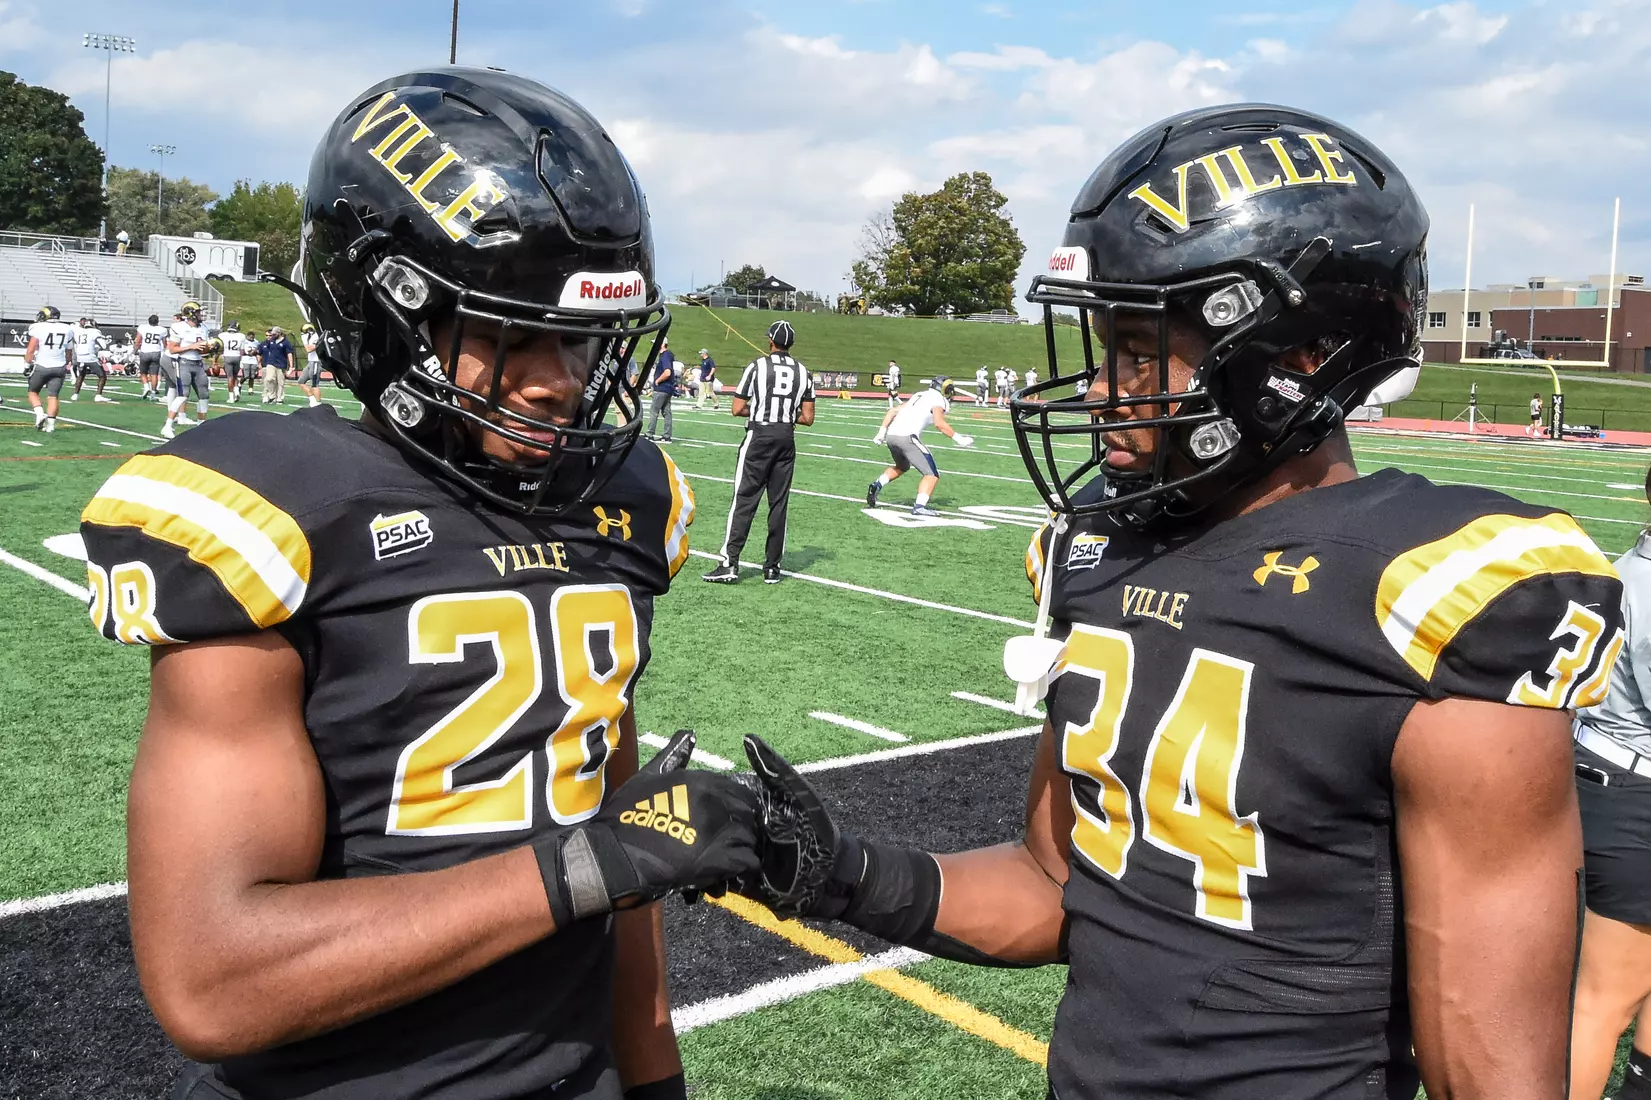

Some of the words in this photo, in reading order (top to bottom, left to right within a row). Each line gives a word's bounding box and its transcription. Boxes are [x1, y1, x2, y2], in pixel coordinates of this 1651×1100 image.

[351, 91, 506, 243] VILLE
[1128, 133, 1358, 233] VILLE
[578, 279, 642, 299] Riddell
[45, 332, 66, 350] 47
[144, 333, 161, 345] 85
[227, 340, 239, 351] 12
[772, 364, 795, 396] B
[376, 519, 429, 549] PSAC
[483, 542, 570, 577] VILLE
[1069, 542, 1104, 560] PSAC
[1122, 584, 1190, 630] VILLE
[385, 583, 640, 837] 28
[1048, 622, 1268, 931] 34
[619, 808, 698, 846] adidas
